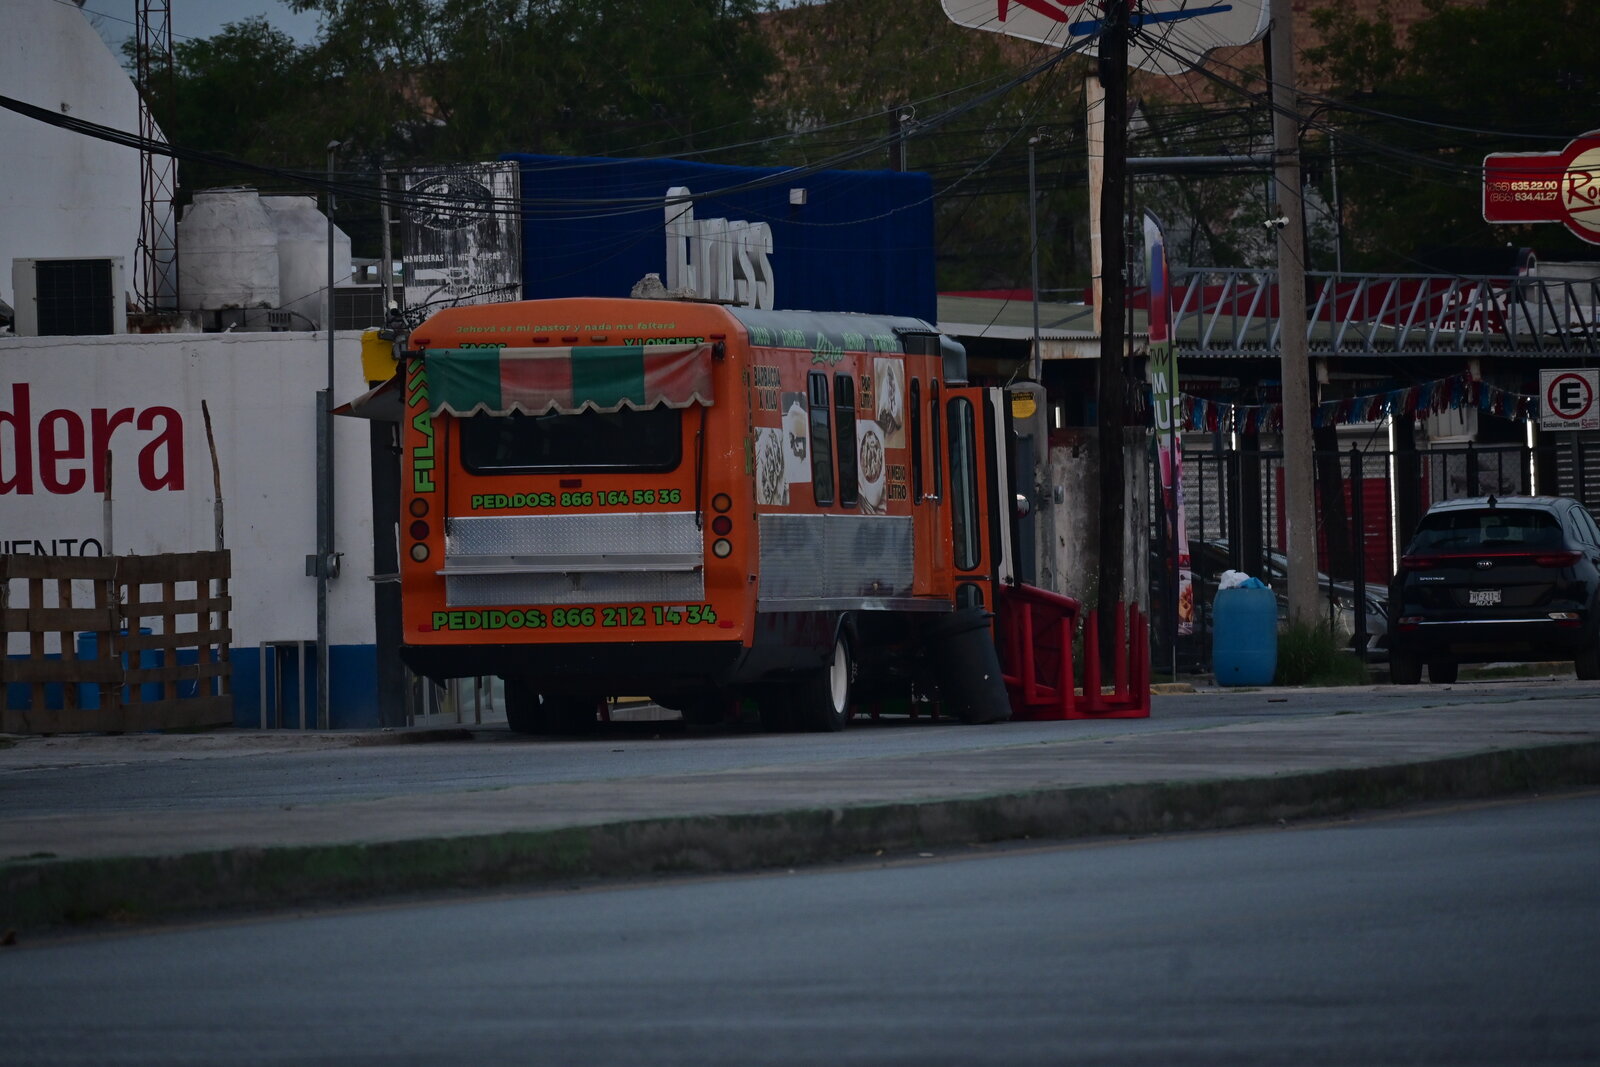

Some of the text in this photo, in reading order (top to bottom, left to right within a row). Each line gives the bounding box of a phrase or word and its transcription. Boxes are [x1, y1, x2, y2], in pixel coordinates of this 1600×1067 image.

[534, 323, 570, 333] pastor
[584, 321, 611, 331] nada
[1560, 383, 1581, 409] E
[412, 409, 435, 493] FILA
[471, 488, 681, 510] PEDIDOS: 866 164 56 36
[888, 483, 907, 500] LITRO
[0, 538, 103, 557] IENTO
[432, 603, 717, 630] PEDIDOS: 866 212 14 34
